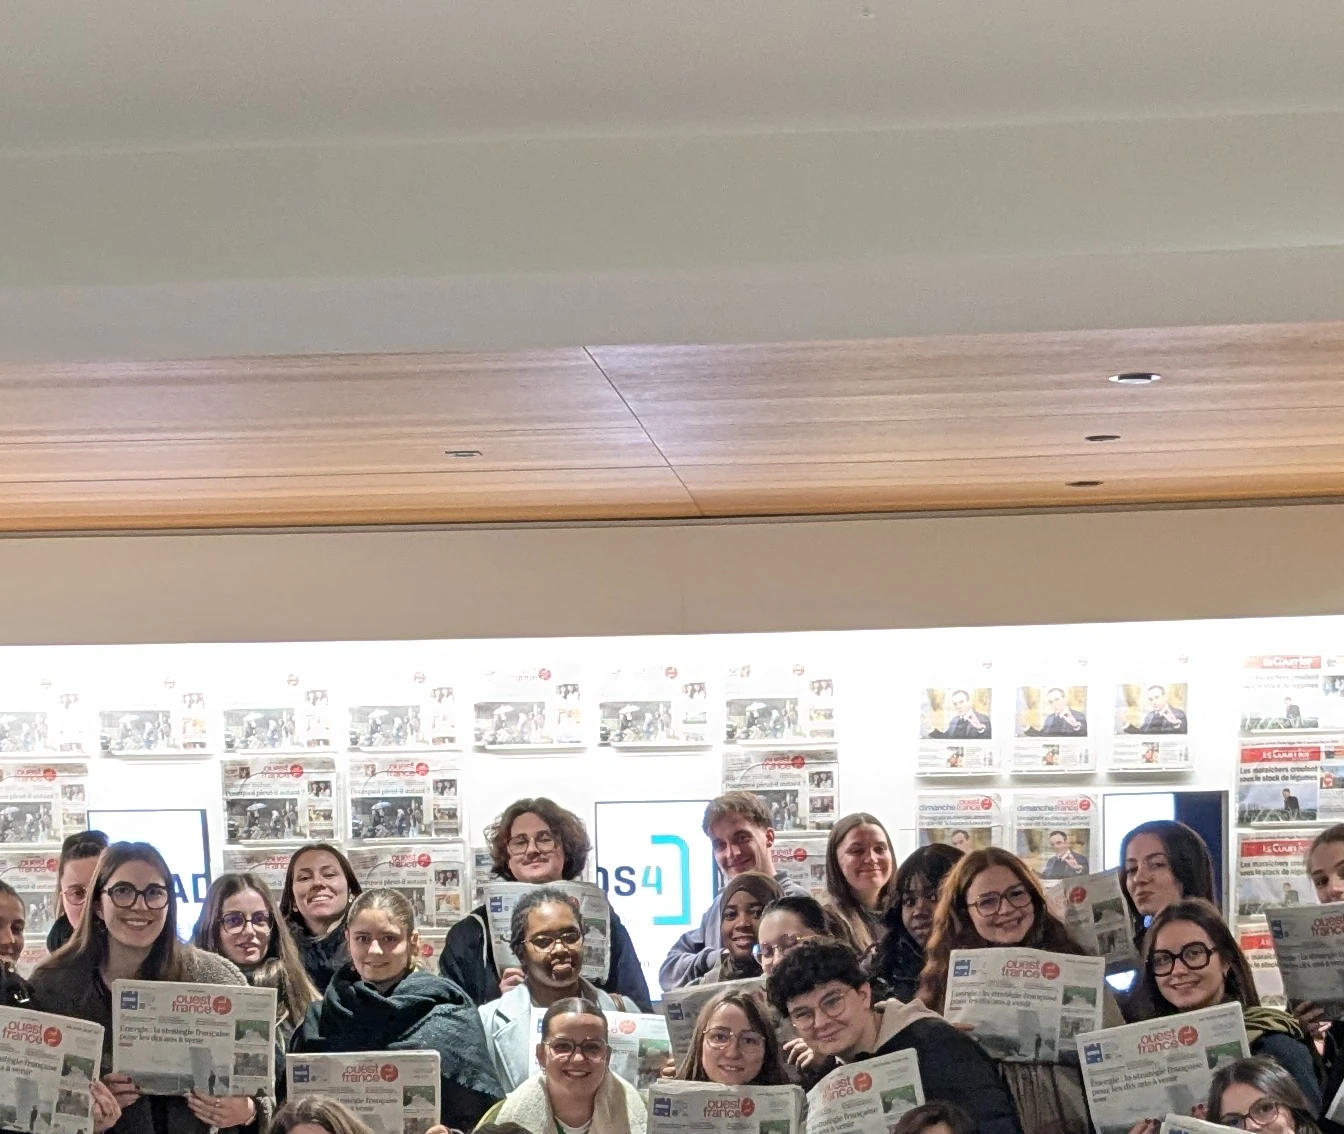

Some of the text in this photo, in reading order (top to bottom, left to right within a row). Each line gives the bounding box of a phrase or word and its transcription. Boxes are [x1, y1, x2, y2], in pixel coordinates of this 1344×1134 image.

[1006, 960, 1040, 969] ouest
[1001, 966, 1040, 978] france
[2, 1026, 43, 1044] france
[8, 1021, 43, 1035] ouest
[1140, 1028, 1176, 1043] ouest
[1138, 1040, 1179, 1054] france
